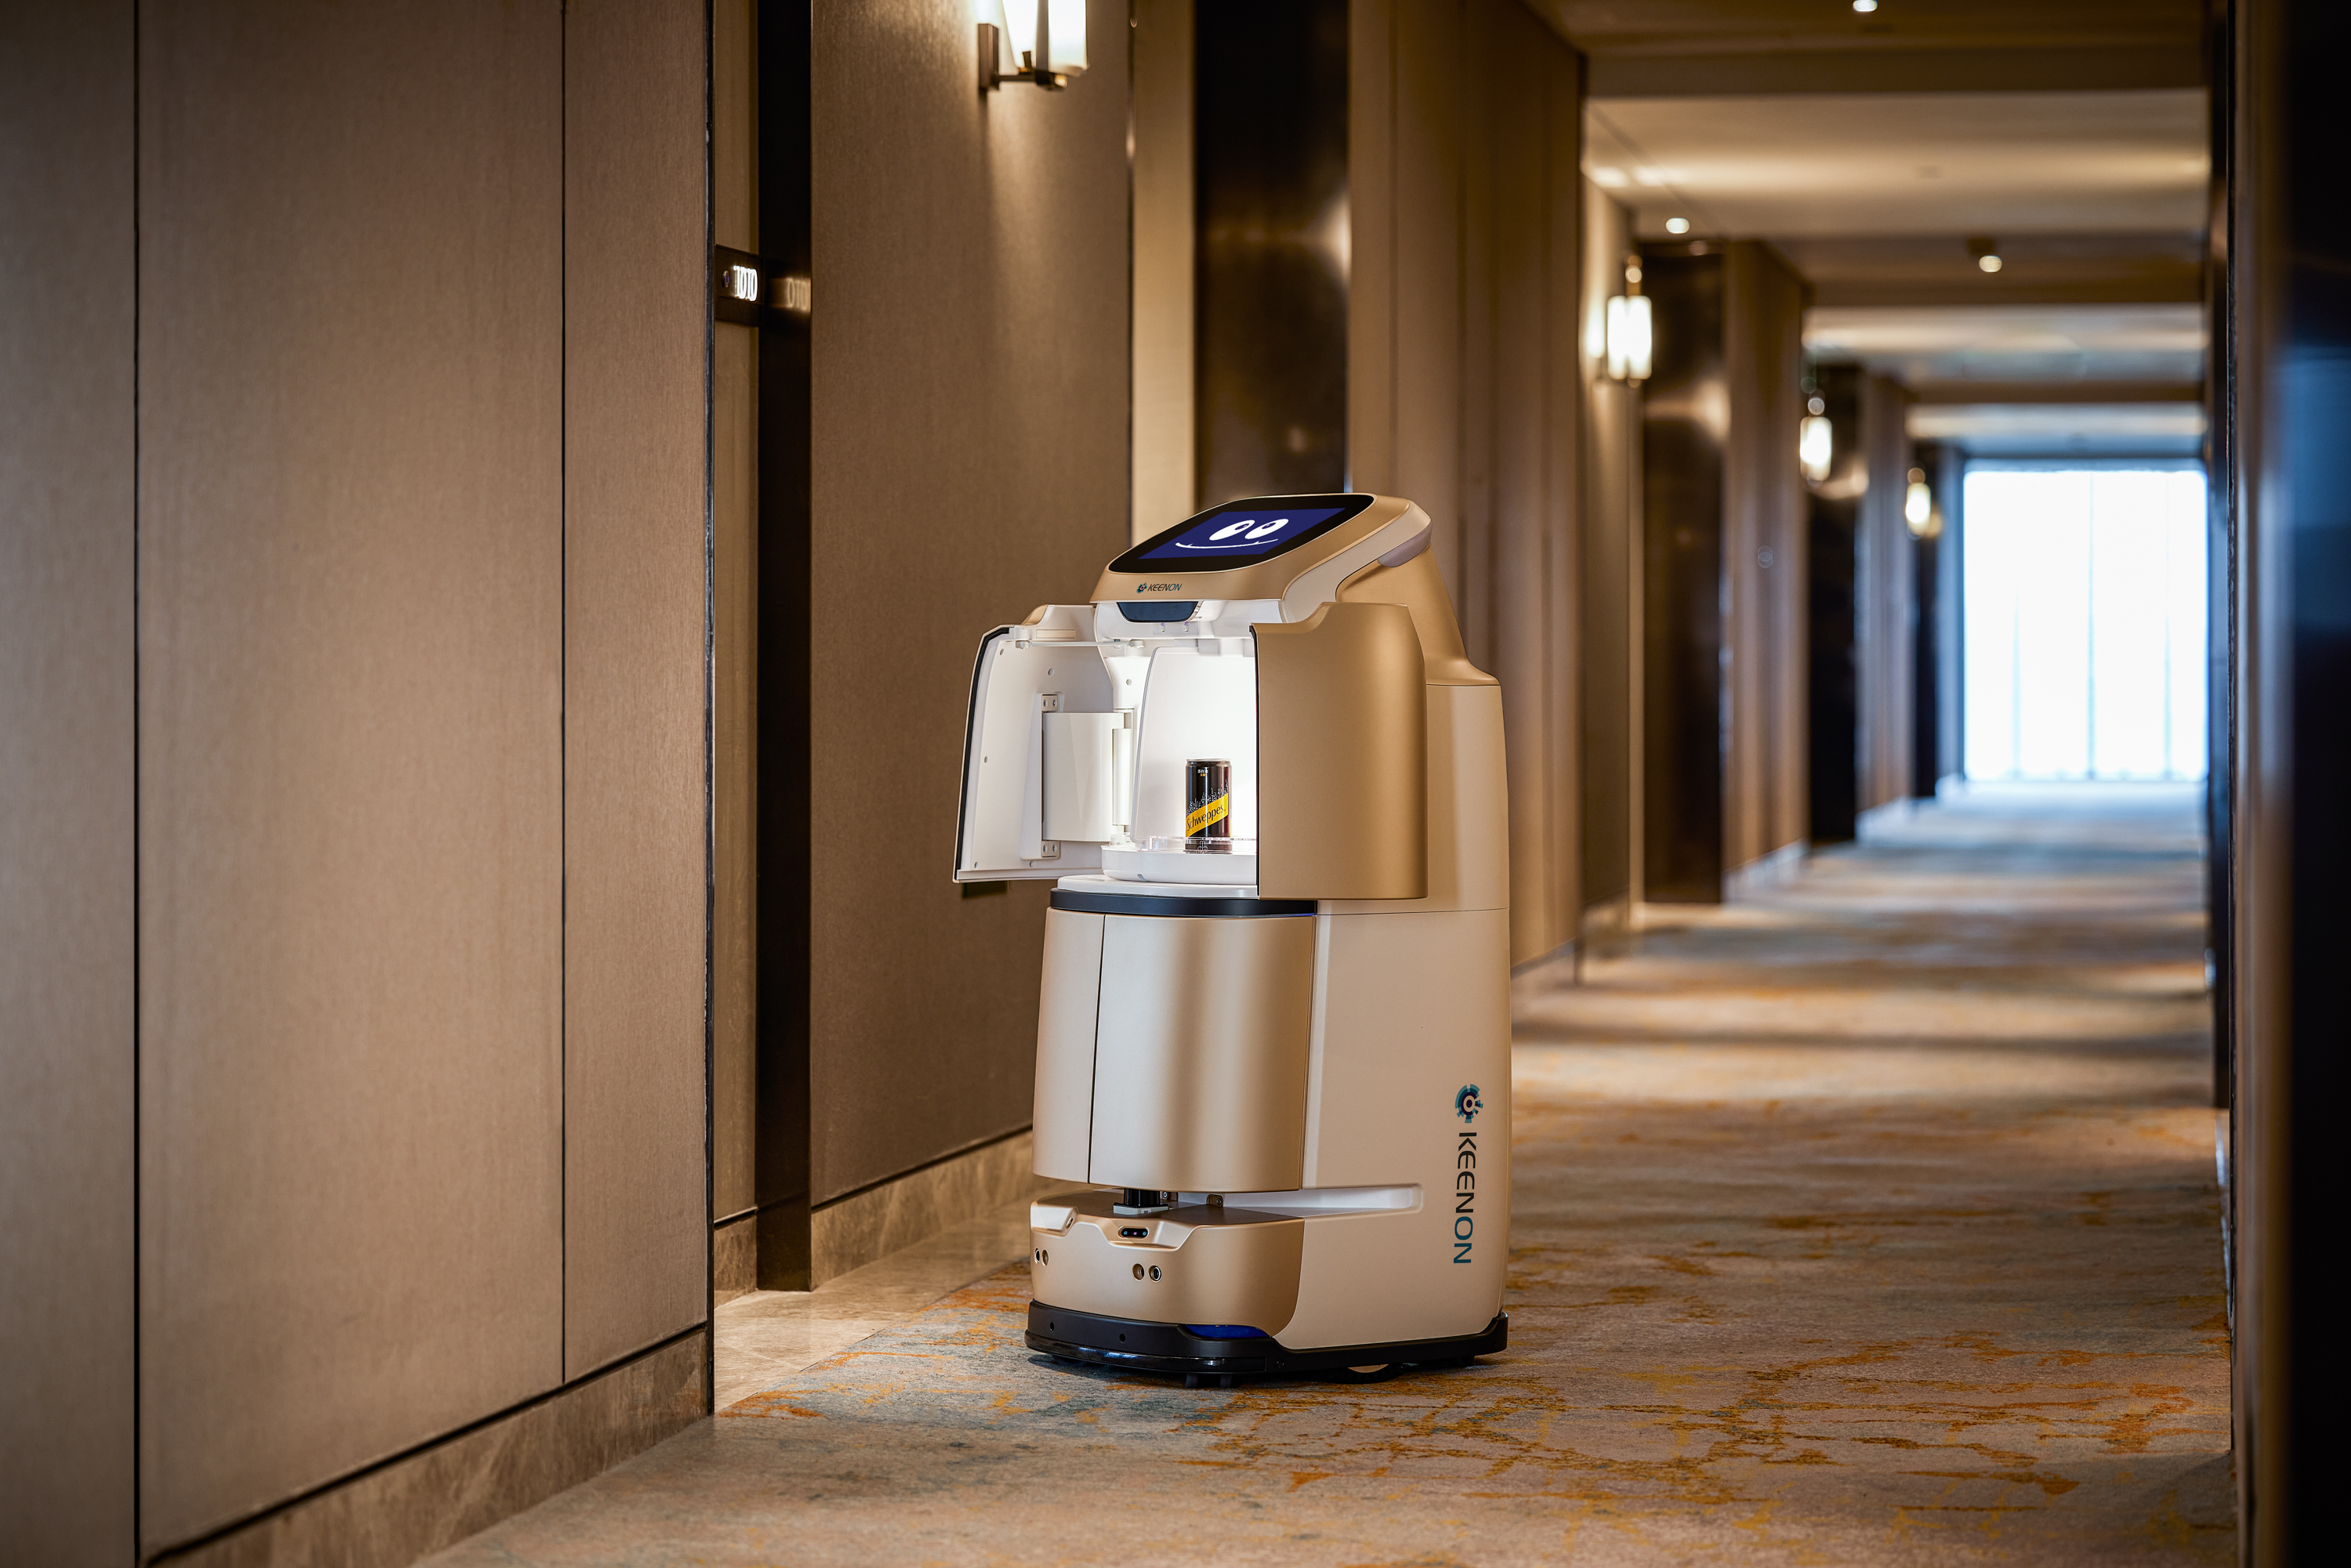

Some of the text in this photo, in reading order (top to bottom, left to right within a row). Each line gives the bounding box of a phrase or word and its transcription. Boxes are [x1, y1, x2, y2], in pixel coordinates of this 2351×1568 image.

[1147, 583, 1183, 592] KEENON
[1186, 804, 1224, 831] Schweppes
[1453, 1132, 1477, 1264] KEENON
